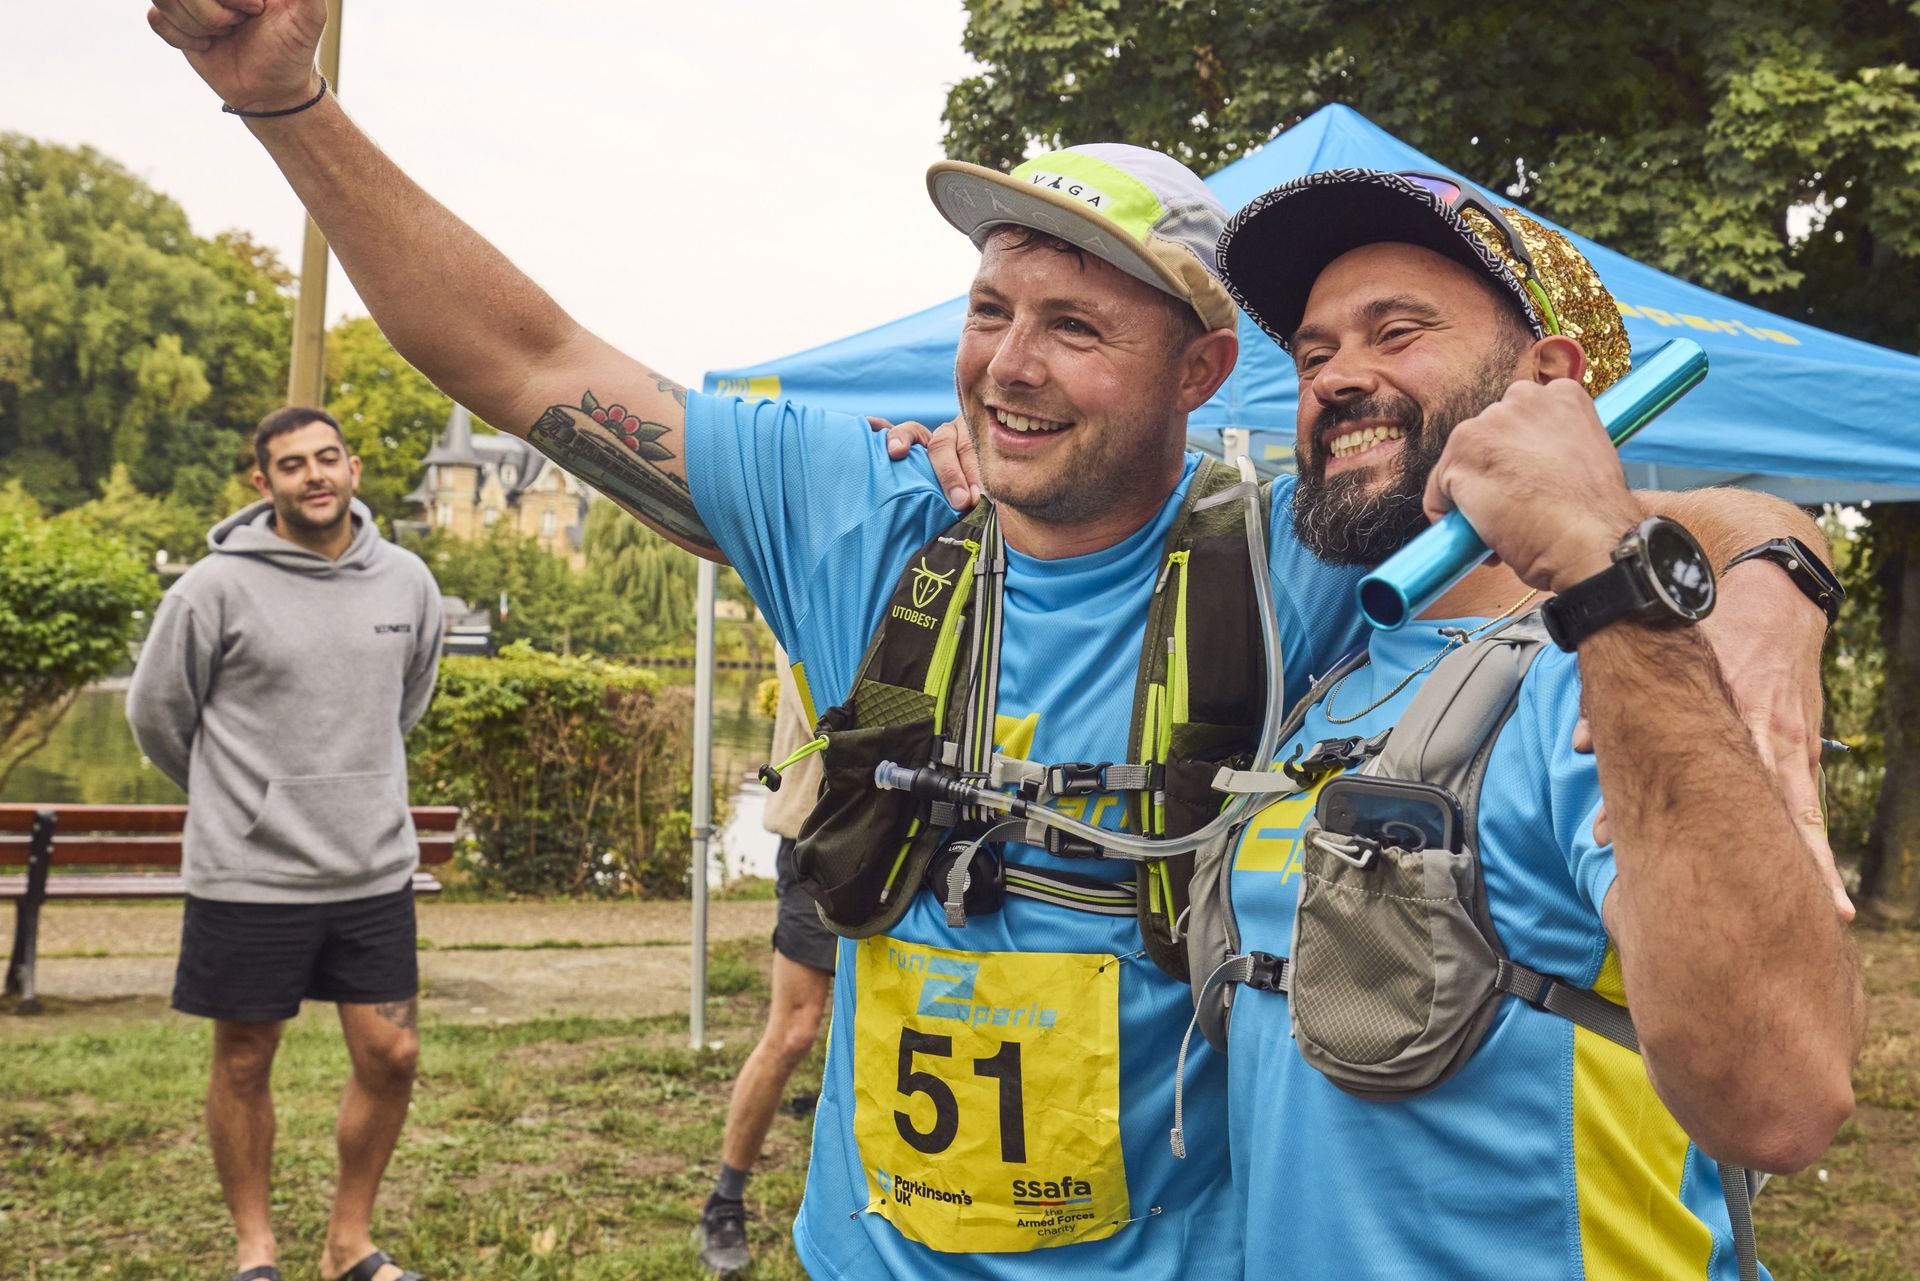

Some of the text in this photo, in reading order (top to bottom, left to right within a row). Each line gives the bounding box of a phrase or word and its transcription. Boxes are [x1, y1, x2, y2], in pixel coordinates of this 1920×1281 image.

[892, 605, 938, 630] UTOBEST
[889, 947, 1058, 1029] run 2 paris
[893, 1026, 1027, 1164] 51
[894, 1174, 973, 1206] Parkinson's
[894, 1188, 912, 1207] UK
[1012, 1176, 1092, 1199] ssafa
[1017, 1212, 1095, 1228] Armed Forces
[1045, 1208, 1064, 1216] the
[1037, 1224, 1076, 1237] charity
